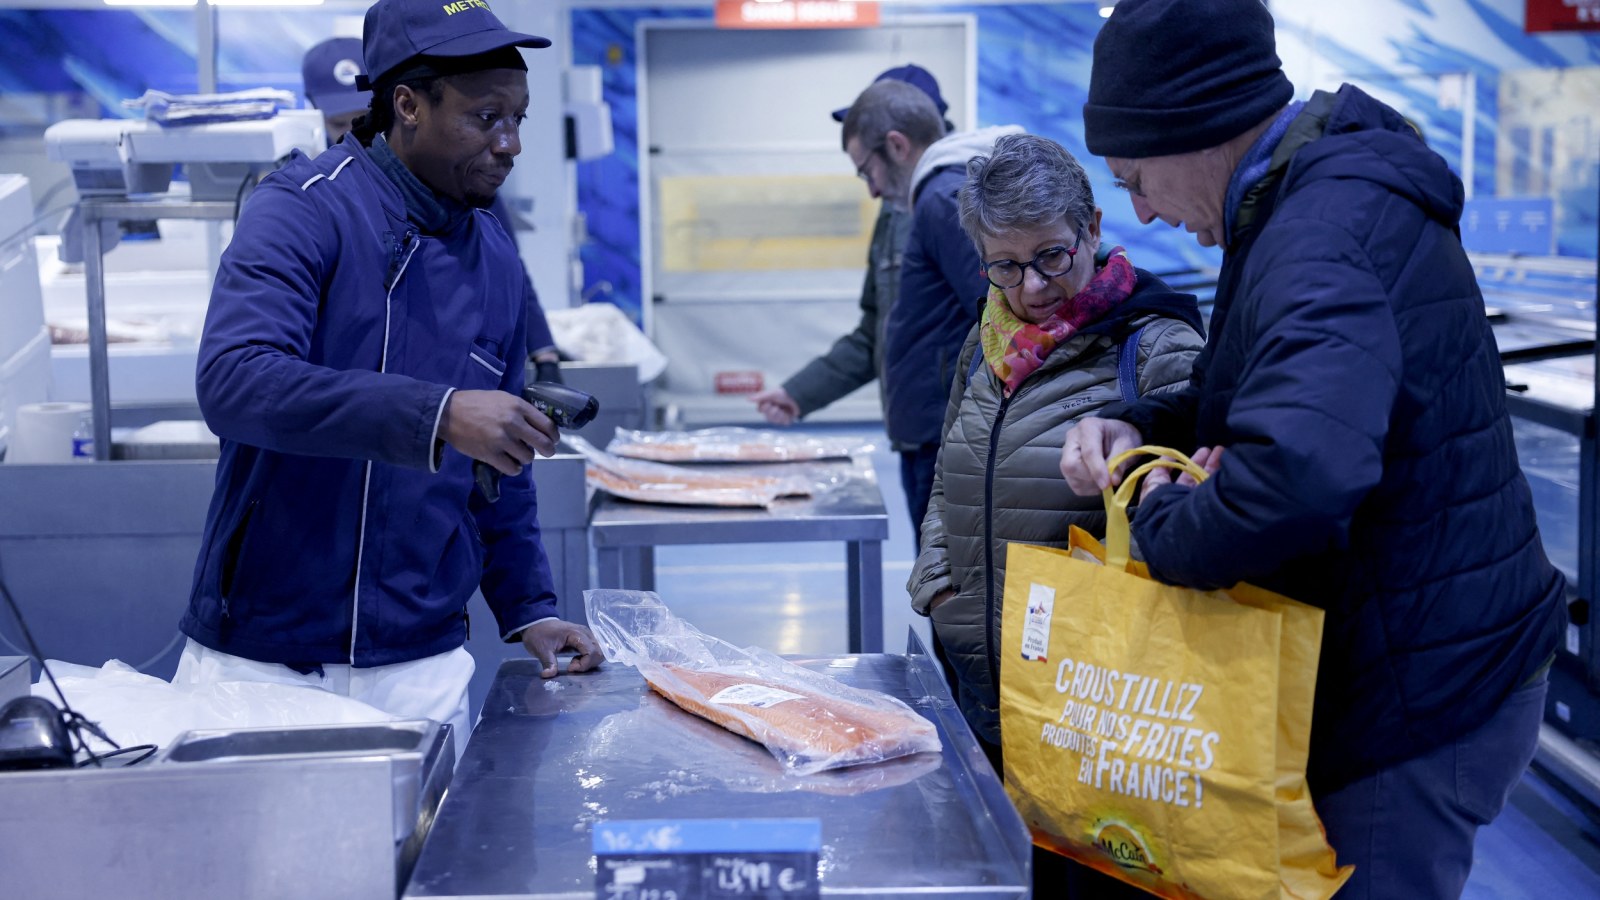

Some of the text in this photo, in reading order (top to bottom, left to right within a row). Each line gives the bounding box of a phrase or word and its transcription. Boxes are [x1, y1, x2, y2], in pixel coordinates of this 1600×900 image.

[1096, 709, 1131, 740] NOS
[1122, 718, 1220, 771] FRITES
[1077, 757, 1094, 785] EN
[1100, 838, 1146, 863] McCain
